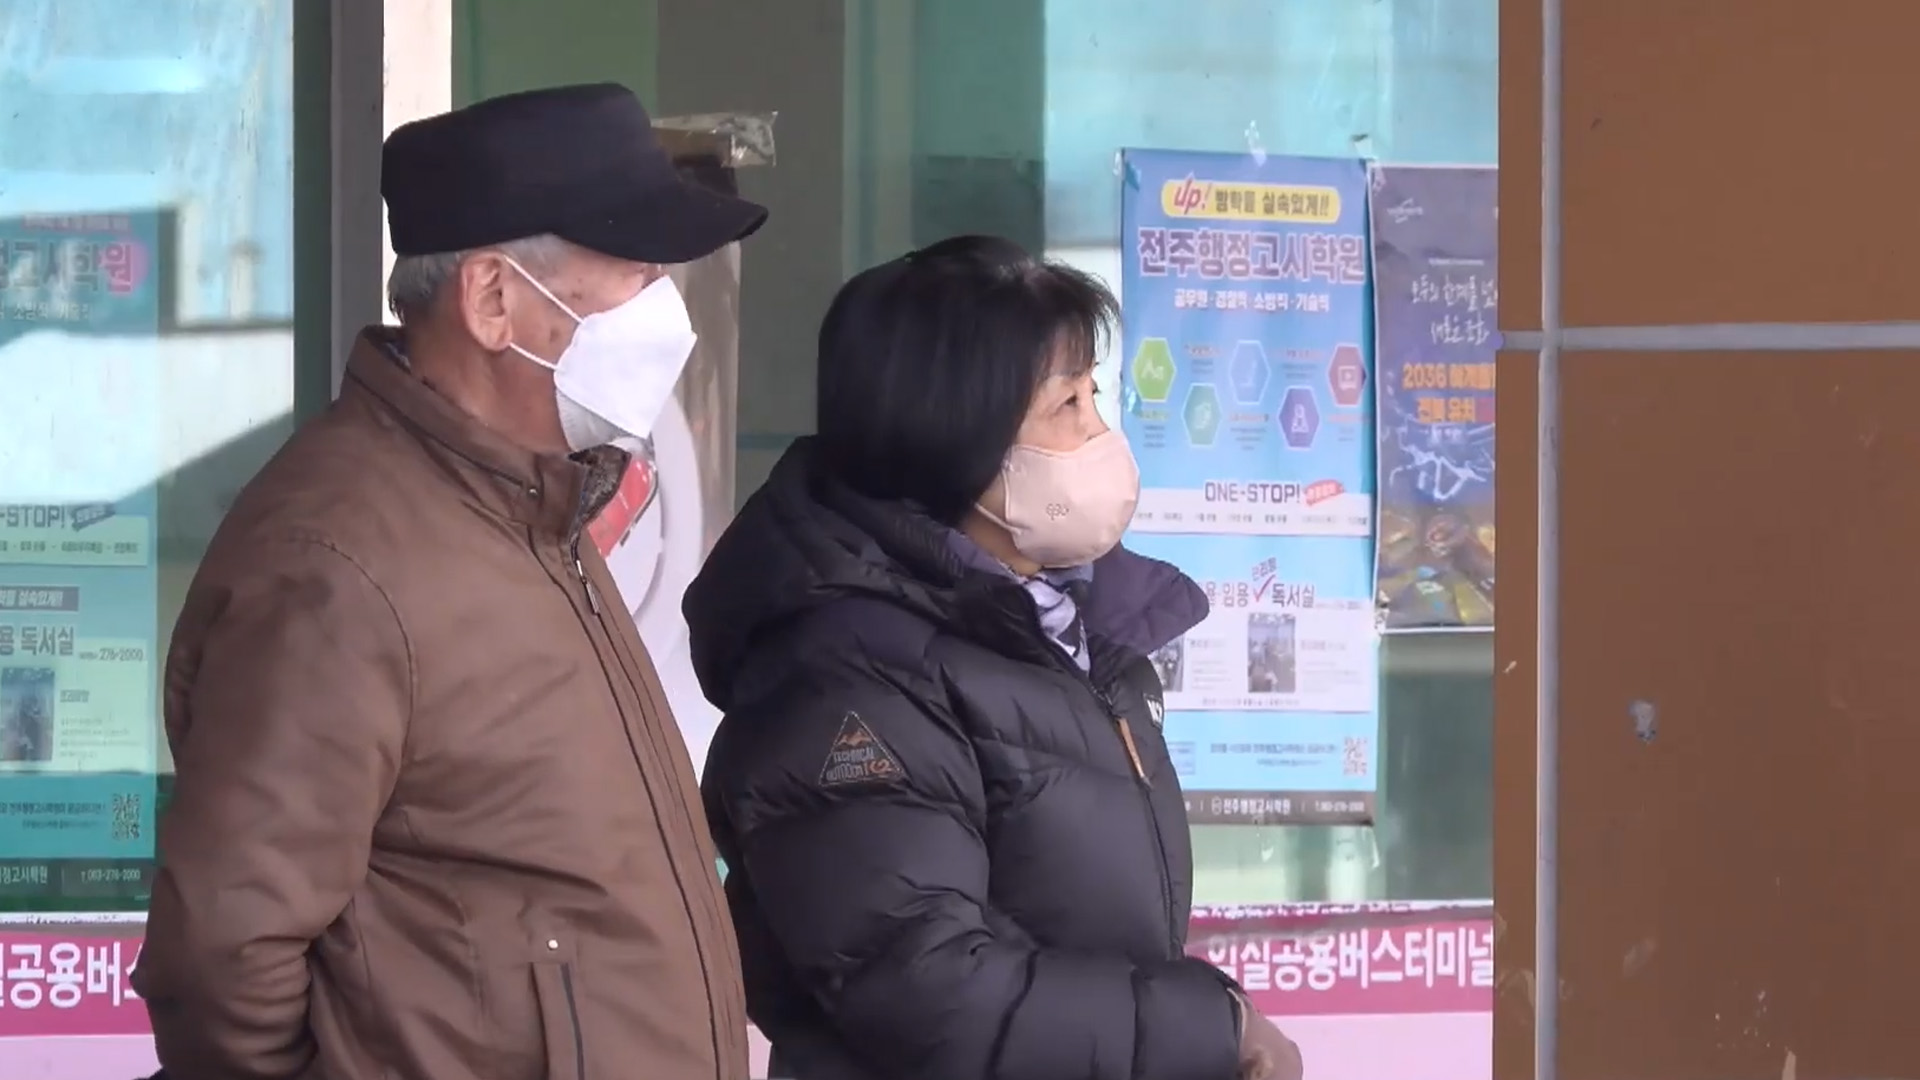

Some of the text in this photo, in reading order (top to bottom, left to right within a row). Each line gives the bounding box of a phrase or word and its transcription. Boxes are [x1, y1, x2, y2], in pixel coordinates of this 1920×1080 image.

[1139, 229, 1365, 283] 전주행정고시학원
[1402, 363, 1447, 390] 2036
[1204, 482, 1301, 504] ONE-STOP!
[1271, 583, 1315, 609] 독서실
[20, 625, 74, 656] 독서실
[0, 942, 144, 1009] 공용버
